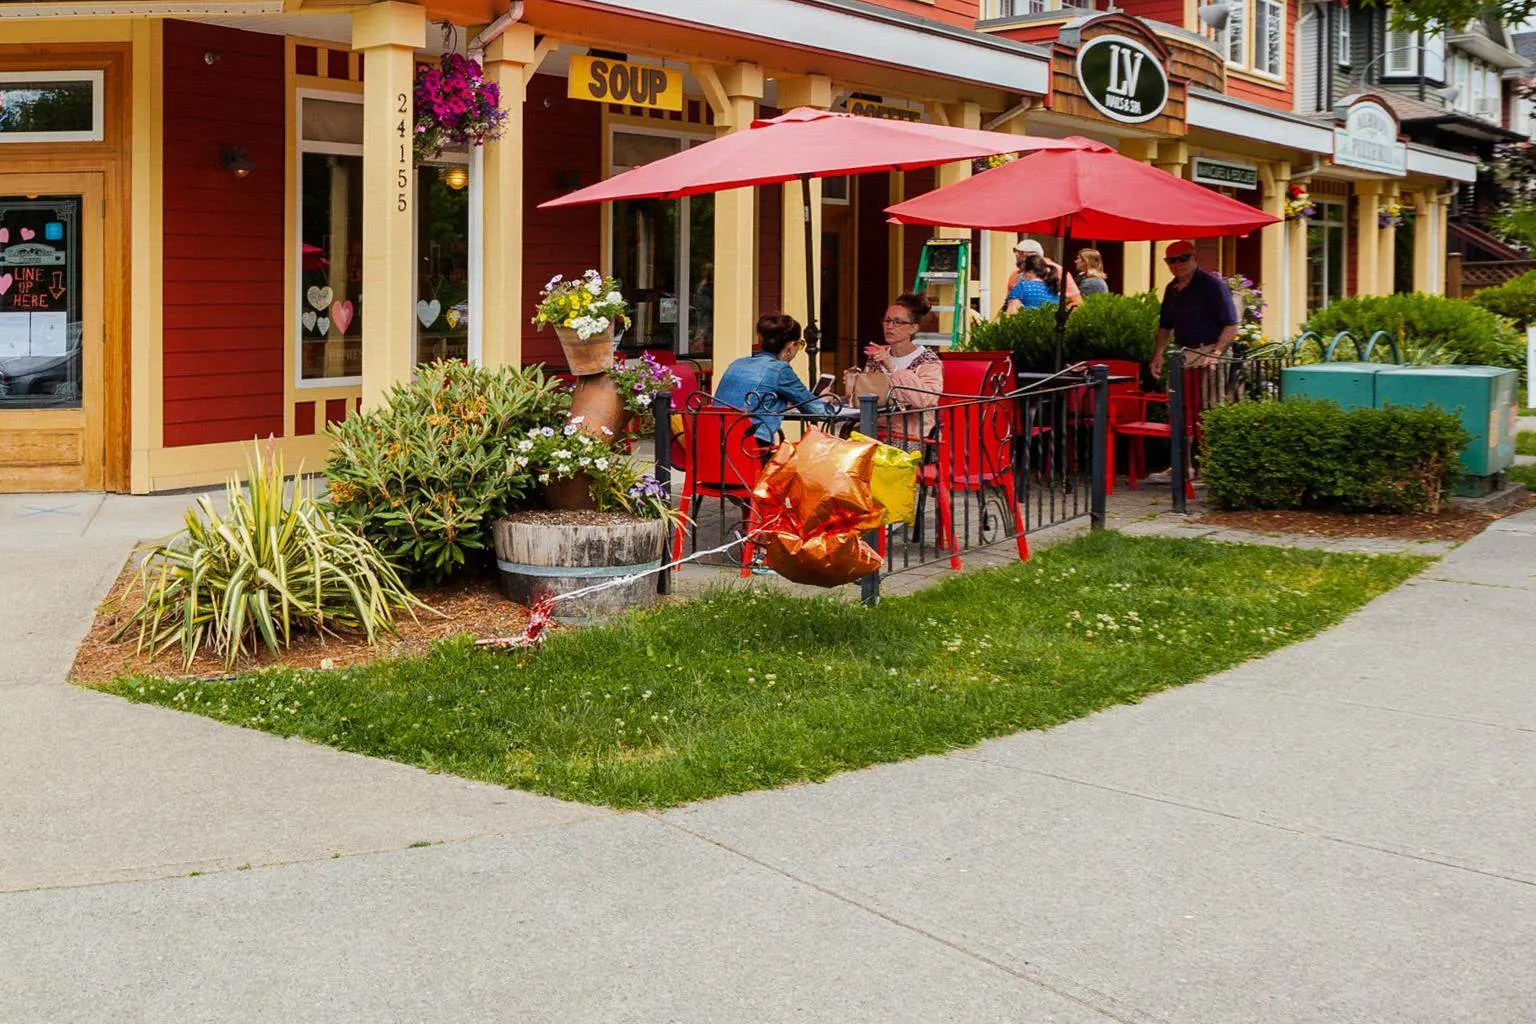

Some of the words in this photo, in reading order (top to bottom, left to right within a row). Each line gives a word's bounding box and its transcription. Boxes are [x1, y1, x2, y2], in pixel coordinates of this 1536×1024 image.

[588, 60, 667, 105] SOUP
[1105, 44, 1144, 98] LV
[397, 93, 408, 212] 24155
[14, 267, 44, 281] LINE
[19, 281, 33, 293] UP
[13, 293, 48, 308] HERE
